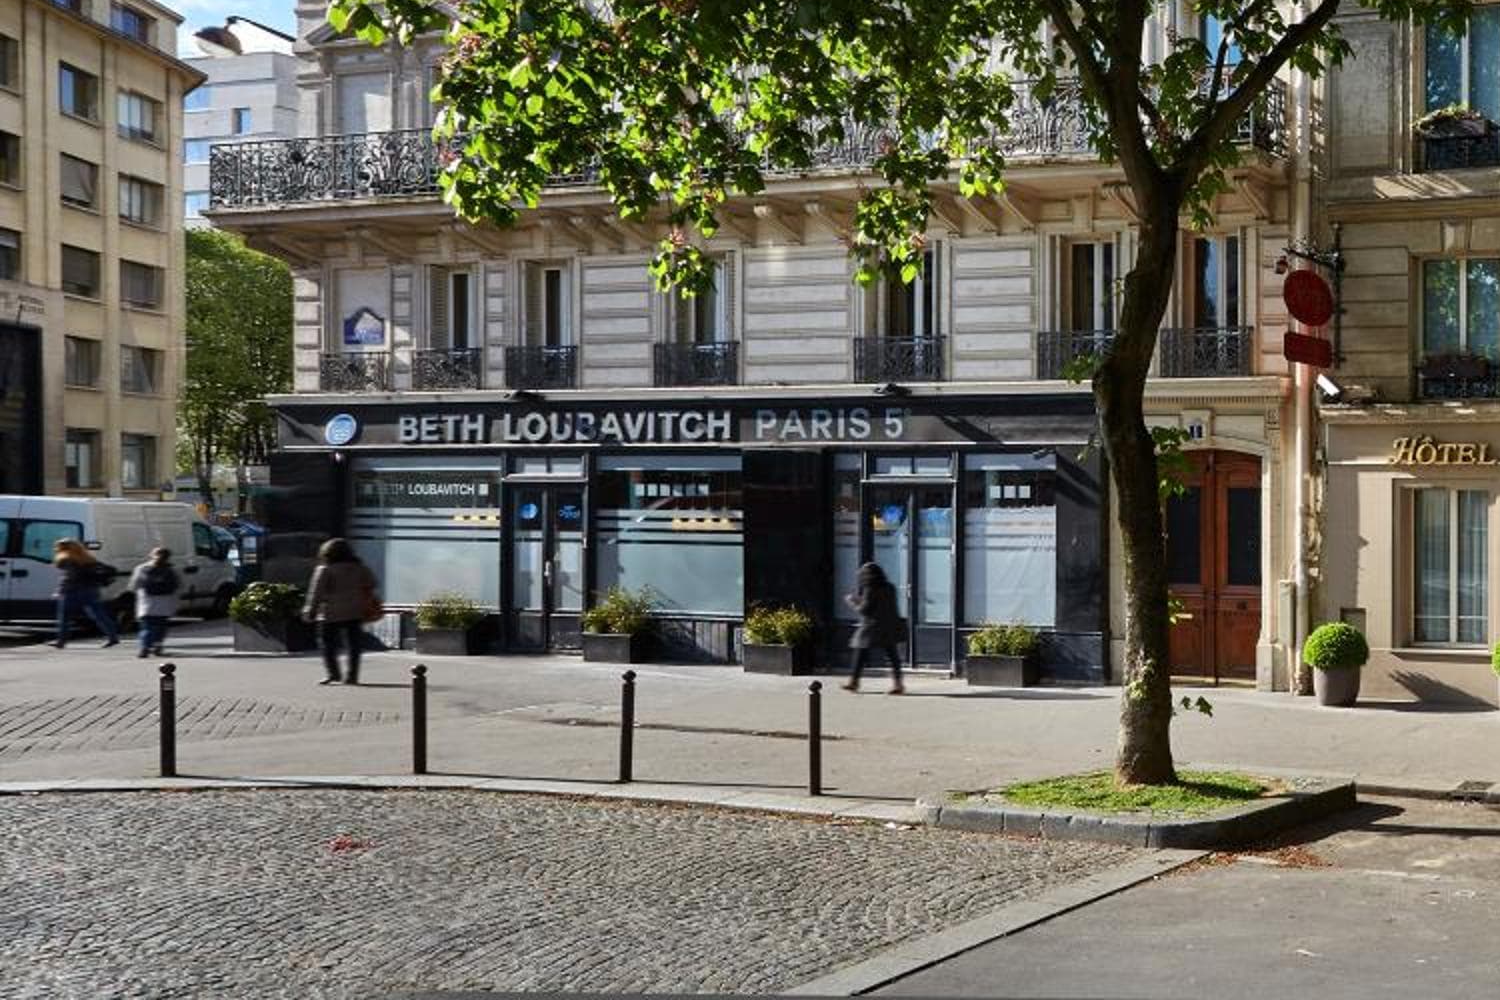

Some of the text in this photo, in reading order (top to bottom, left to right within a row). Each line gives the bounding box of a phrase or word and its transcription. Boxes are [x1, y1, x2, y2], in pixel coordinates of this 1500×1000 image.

[400, 414, 484, 441] BETH
[503, 410, 731, 441] LOUBAVITCH
[755, 408, 871, 439] PARIS
[1389, 436, 1498, 465] HÔTEL
[408, 483, 475, 495] LOUBAVITCH
